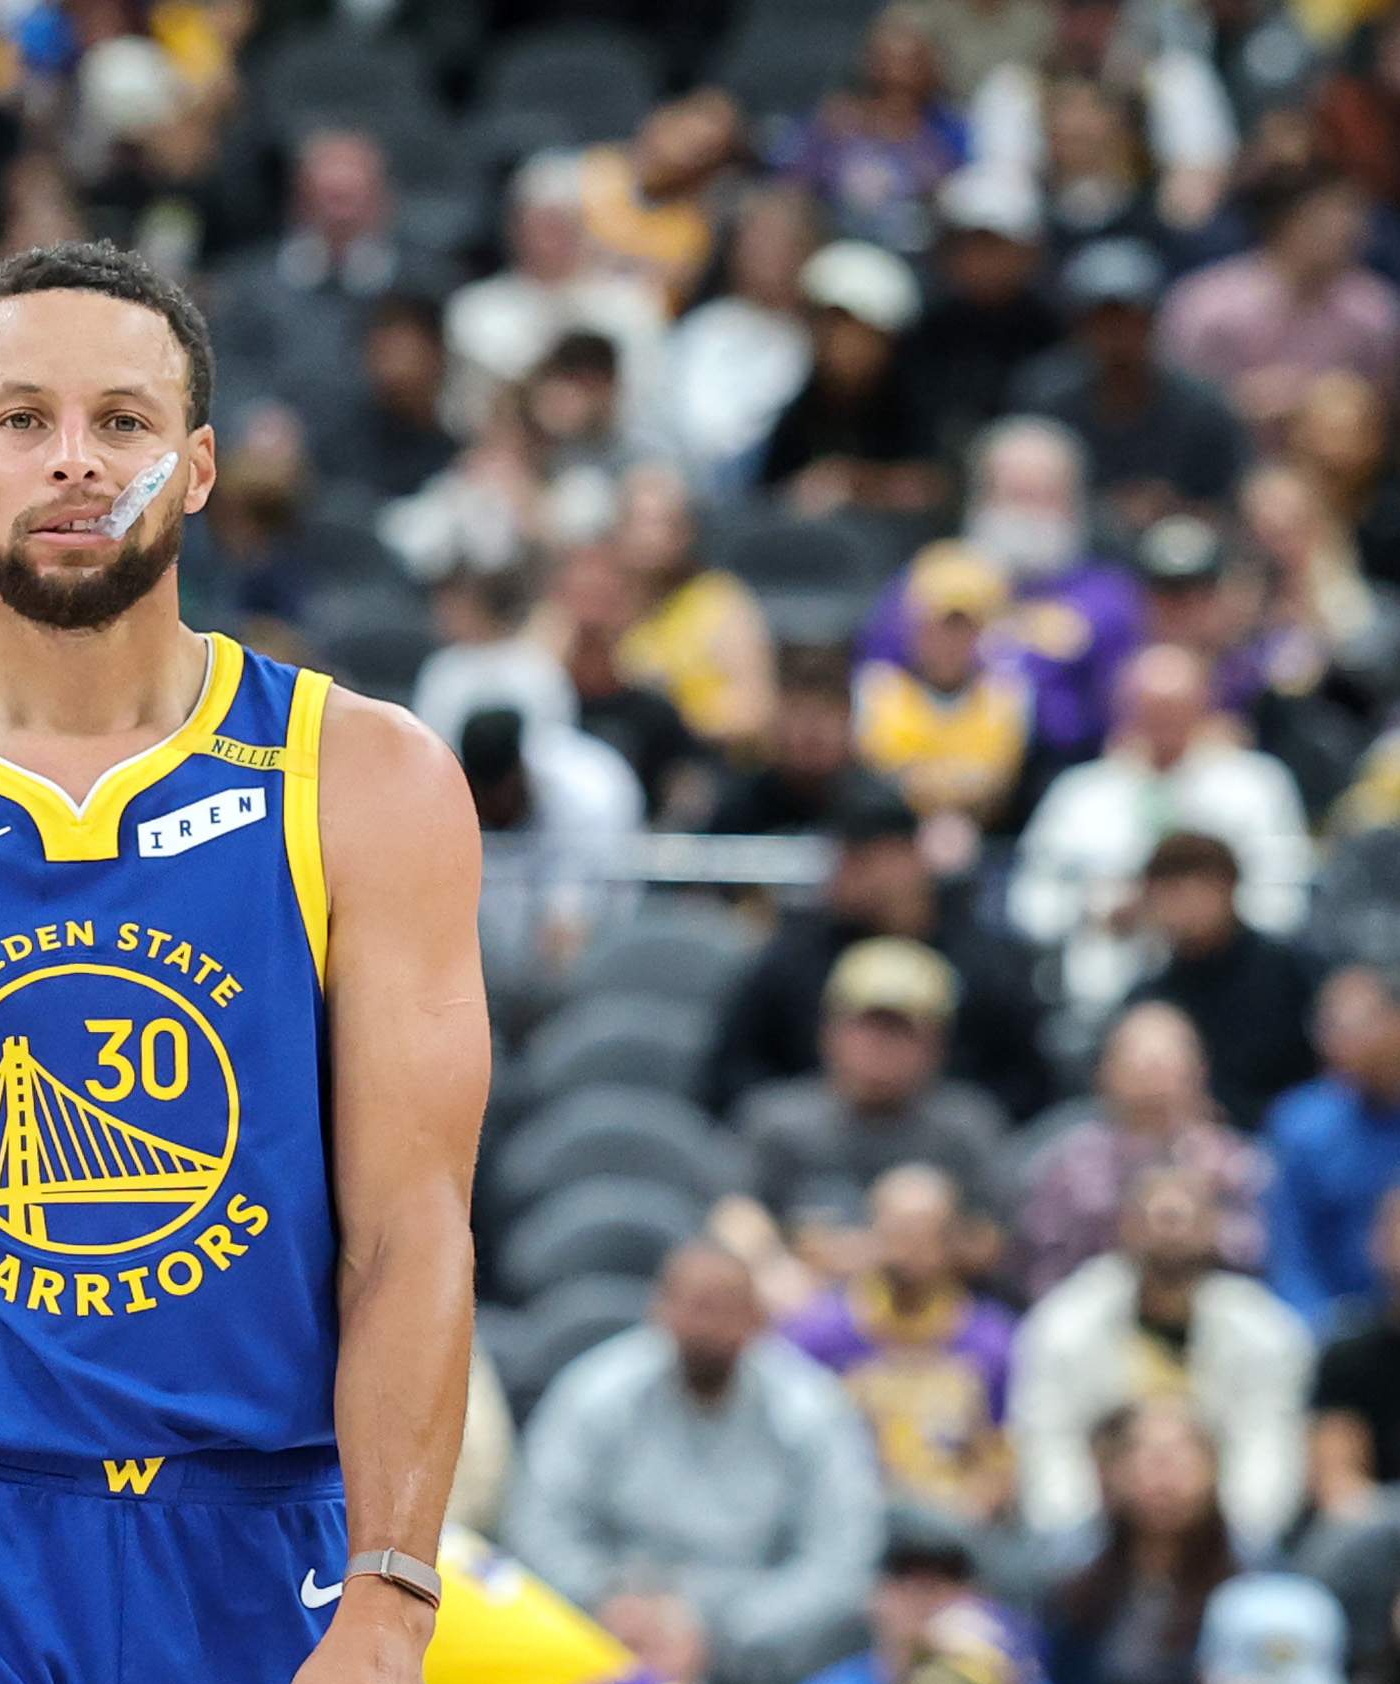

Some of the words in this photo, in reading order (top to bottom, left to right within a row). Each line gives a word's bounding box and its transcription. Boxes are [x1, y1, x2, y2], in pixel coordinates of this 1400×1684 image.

[211, 738, 280, 768] NELLIE
[151, 796, 252, 850] IREN
[116, 922, 244, 1009] STATE
[84, 1017, 189, 1103] 30
[103, 1456, 166, 1496] W
